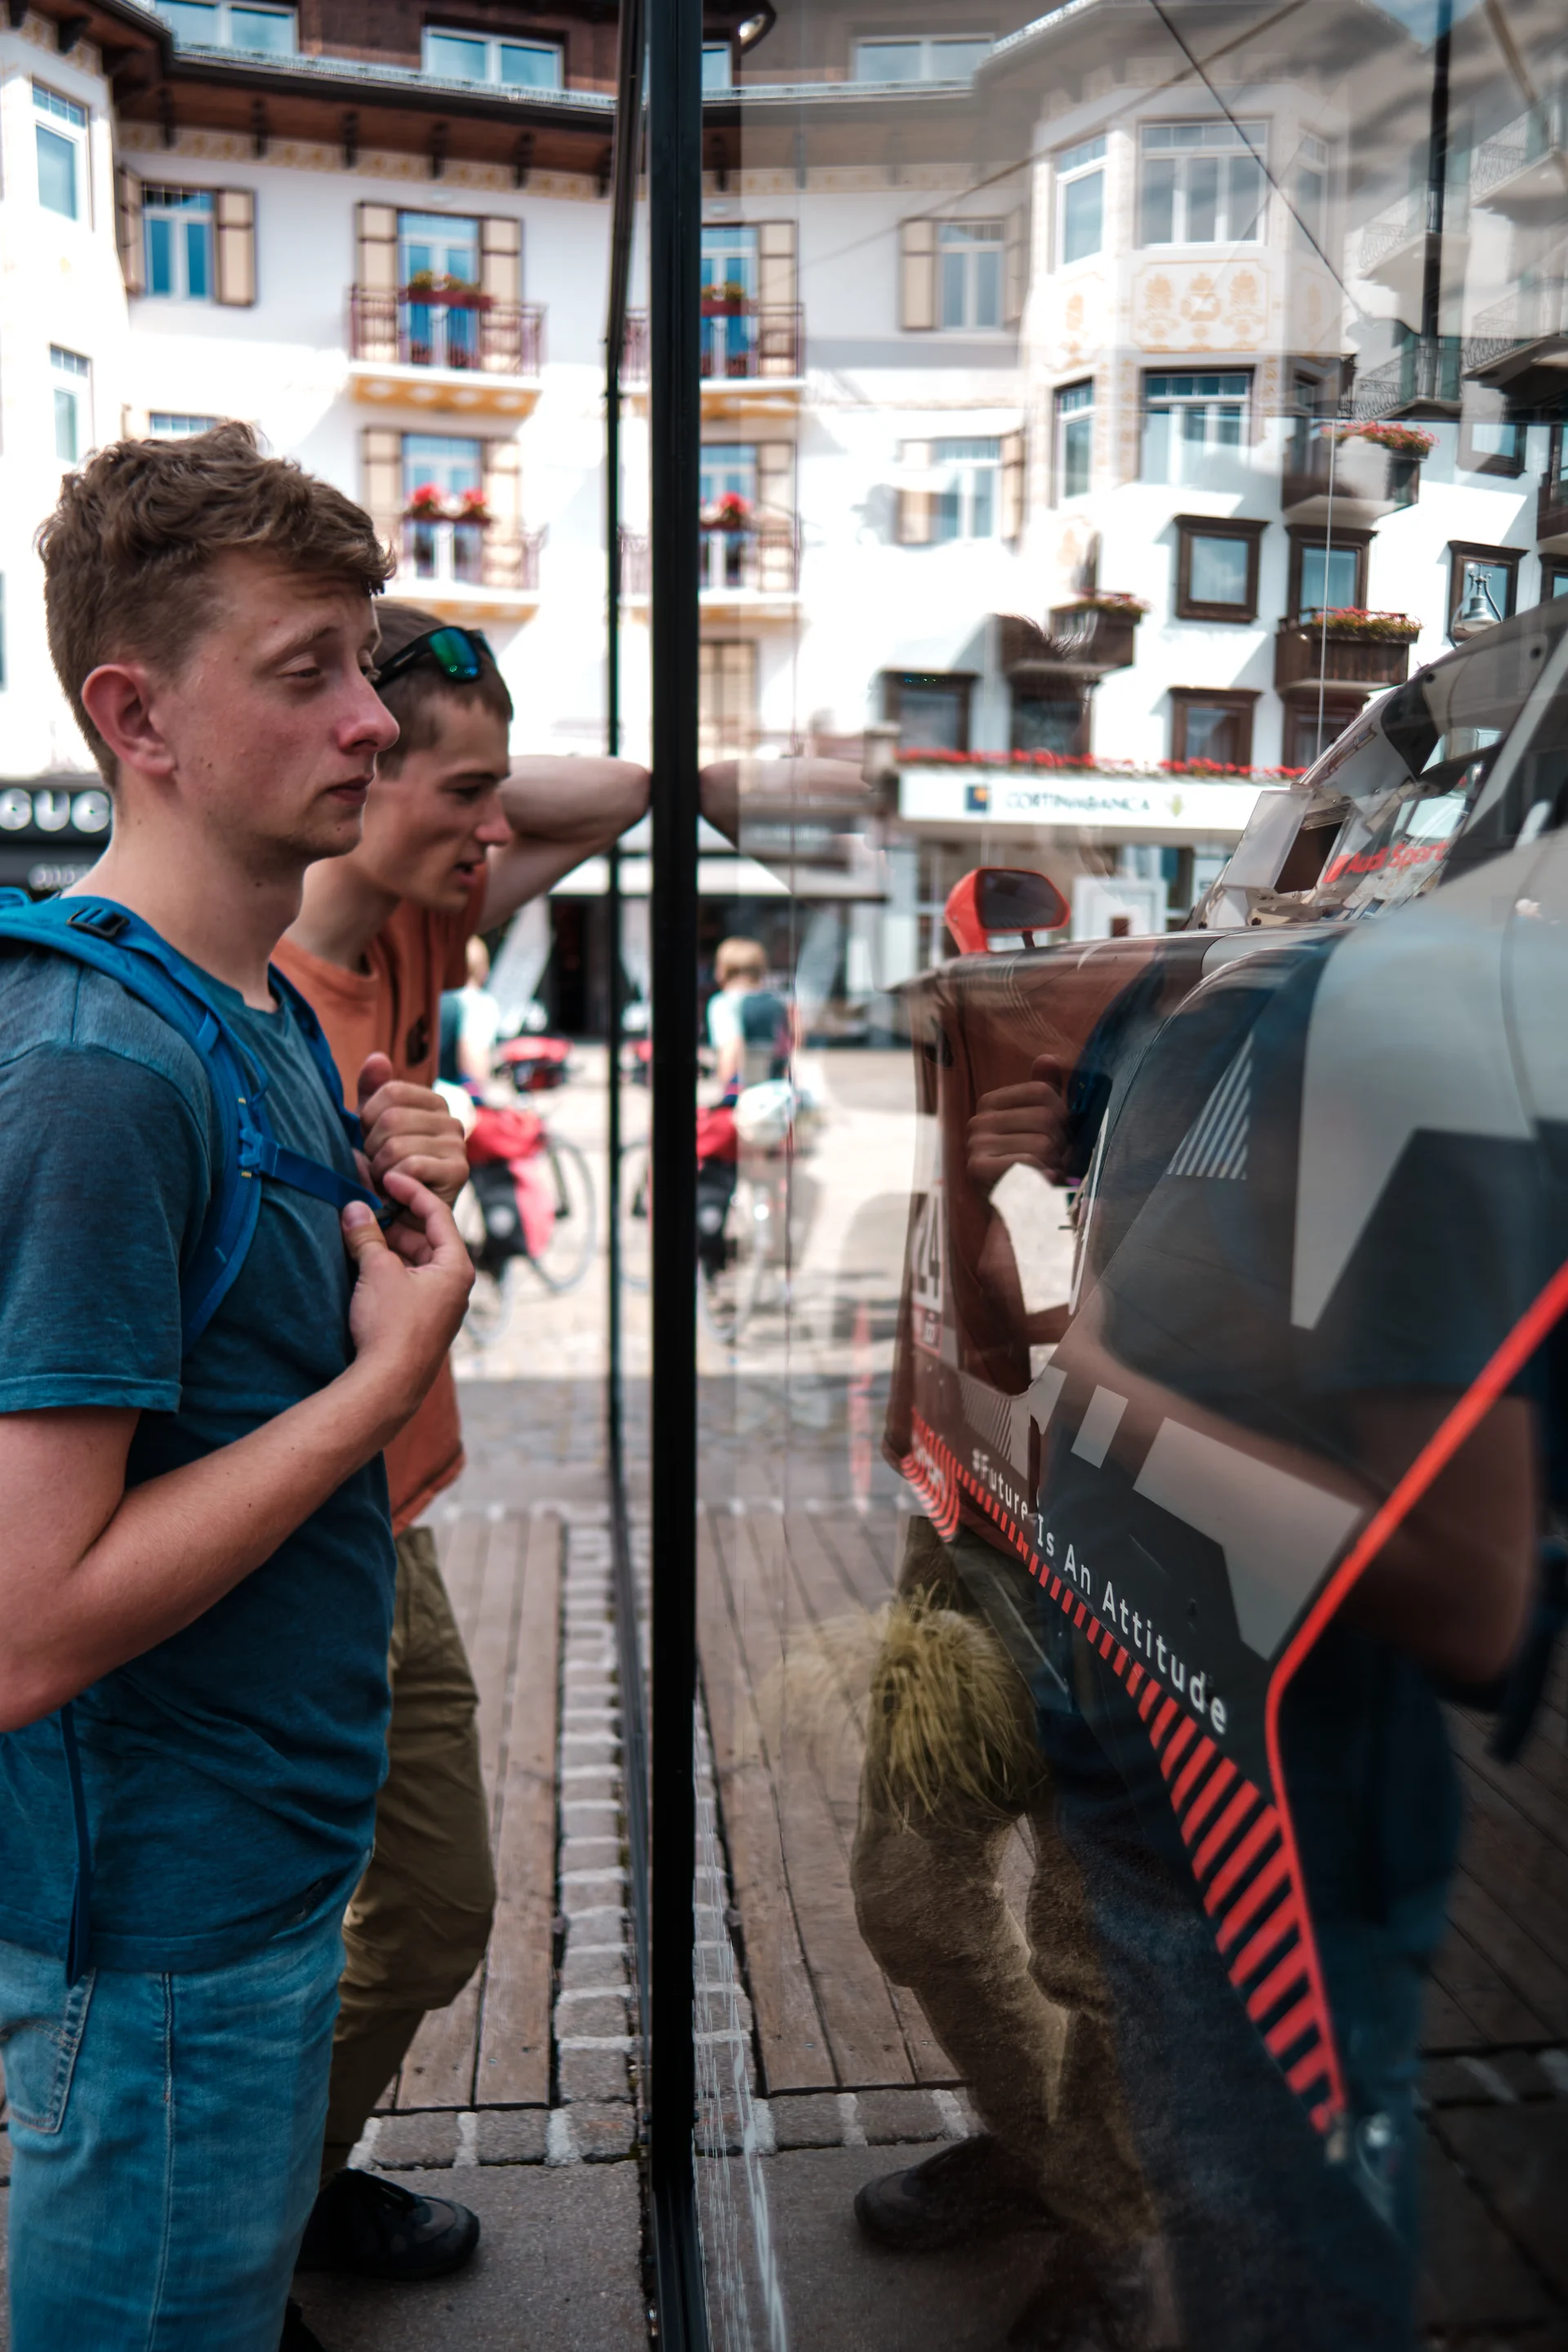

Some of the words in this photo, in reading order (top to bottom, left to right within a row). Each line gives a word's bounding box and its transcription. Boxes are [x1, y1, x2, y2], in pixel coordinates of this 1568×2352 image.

[1344, 847, 1389, 875] Audi
[1388, 839, 1449, 871] Sport
[972, 1448, 1028, 1521] #Future
[1037, 1513, 1054, 1557] Is
[1064, 1544, 1091, 1595] An
[1102, 1581, 1227, 1735] Attitude
